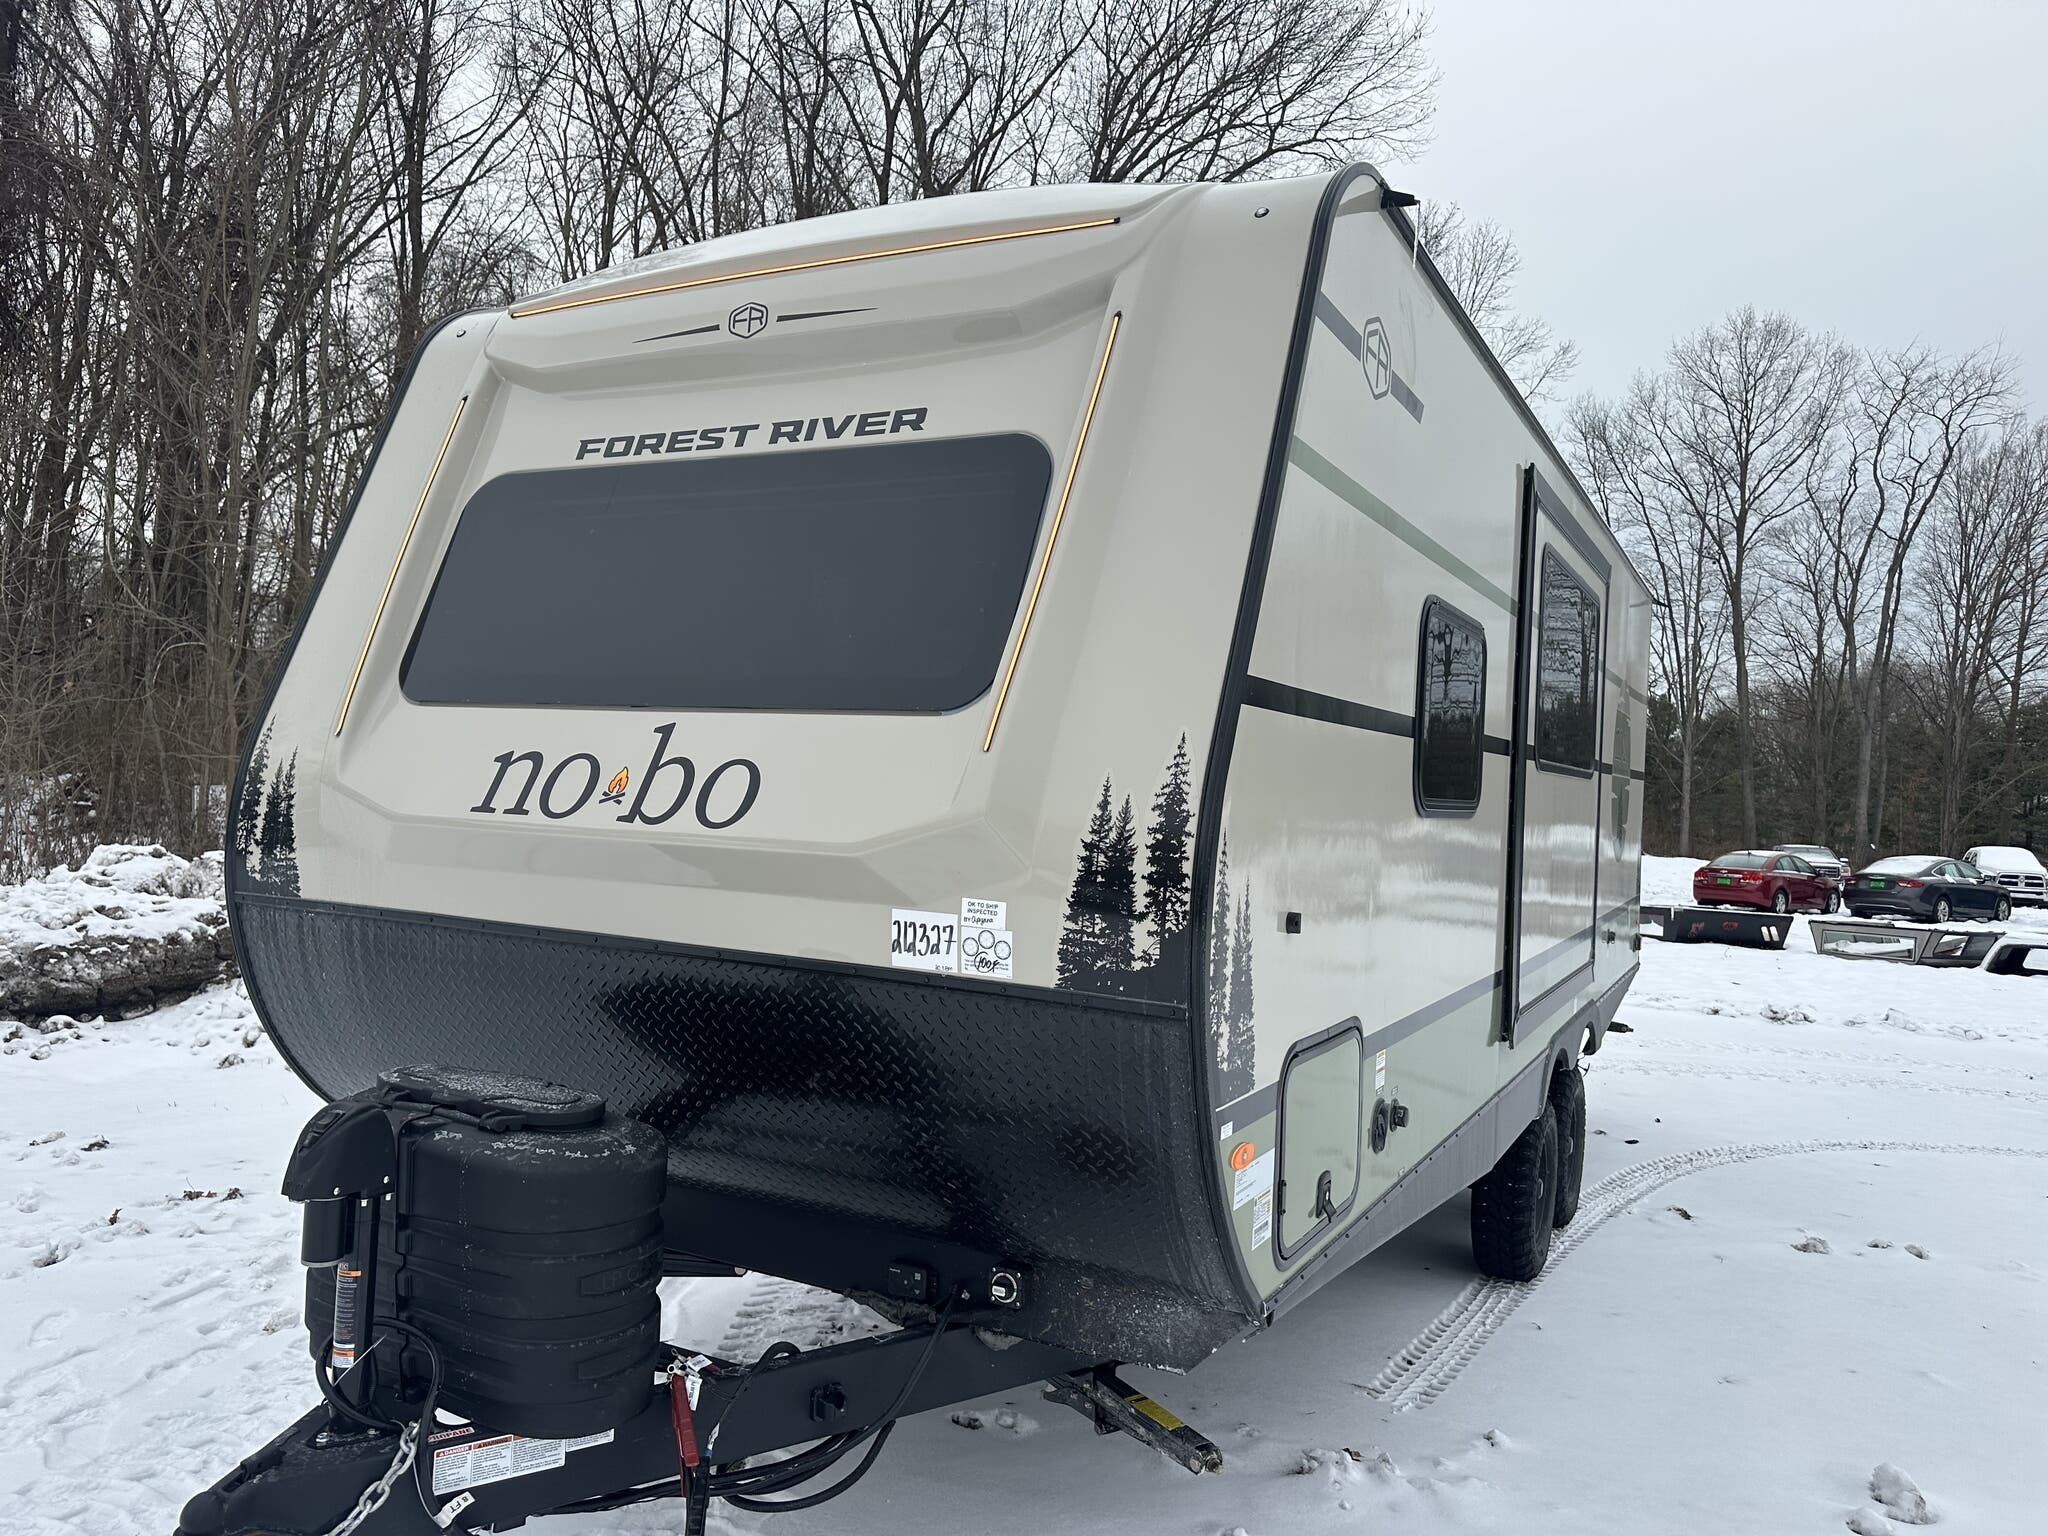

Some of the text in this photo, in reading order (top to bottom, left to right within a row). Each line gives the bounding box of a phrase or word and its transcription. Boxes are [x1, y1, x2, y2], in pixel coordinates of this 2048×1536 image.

[575, 407, 928, 460] FOREST RIVER
[967, 908, 998, 916] INSPECTED
[444, 1445, 470, 1456] DANGER
